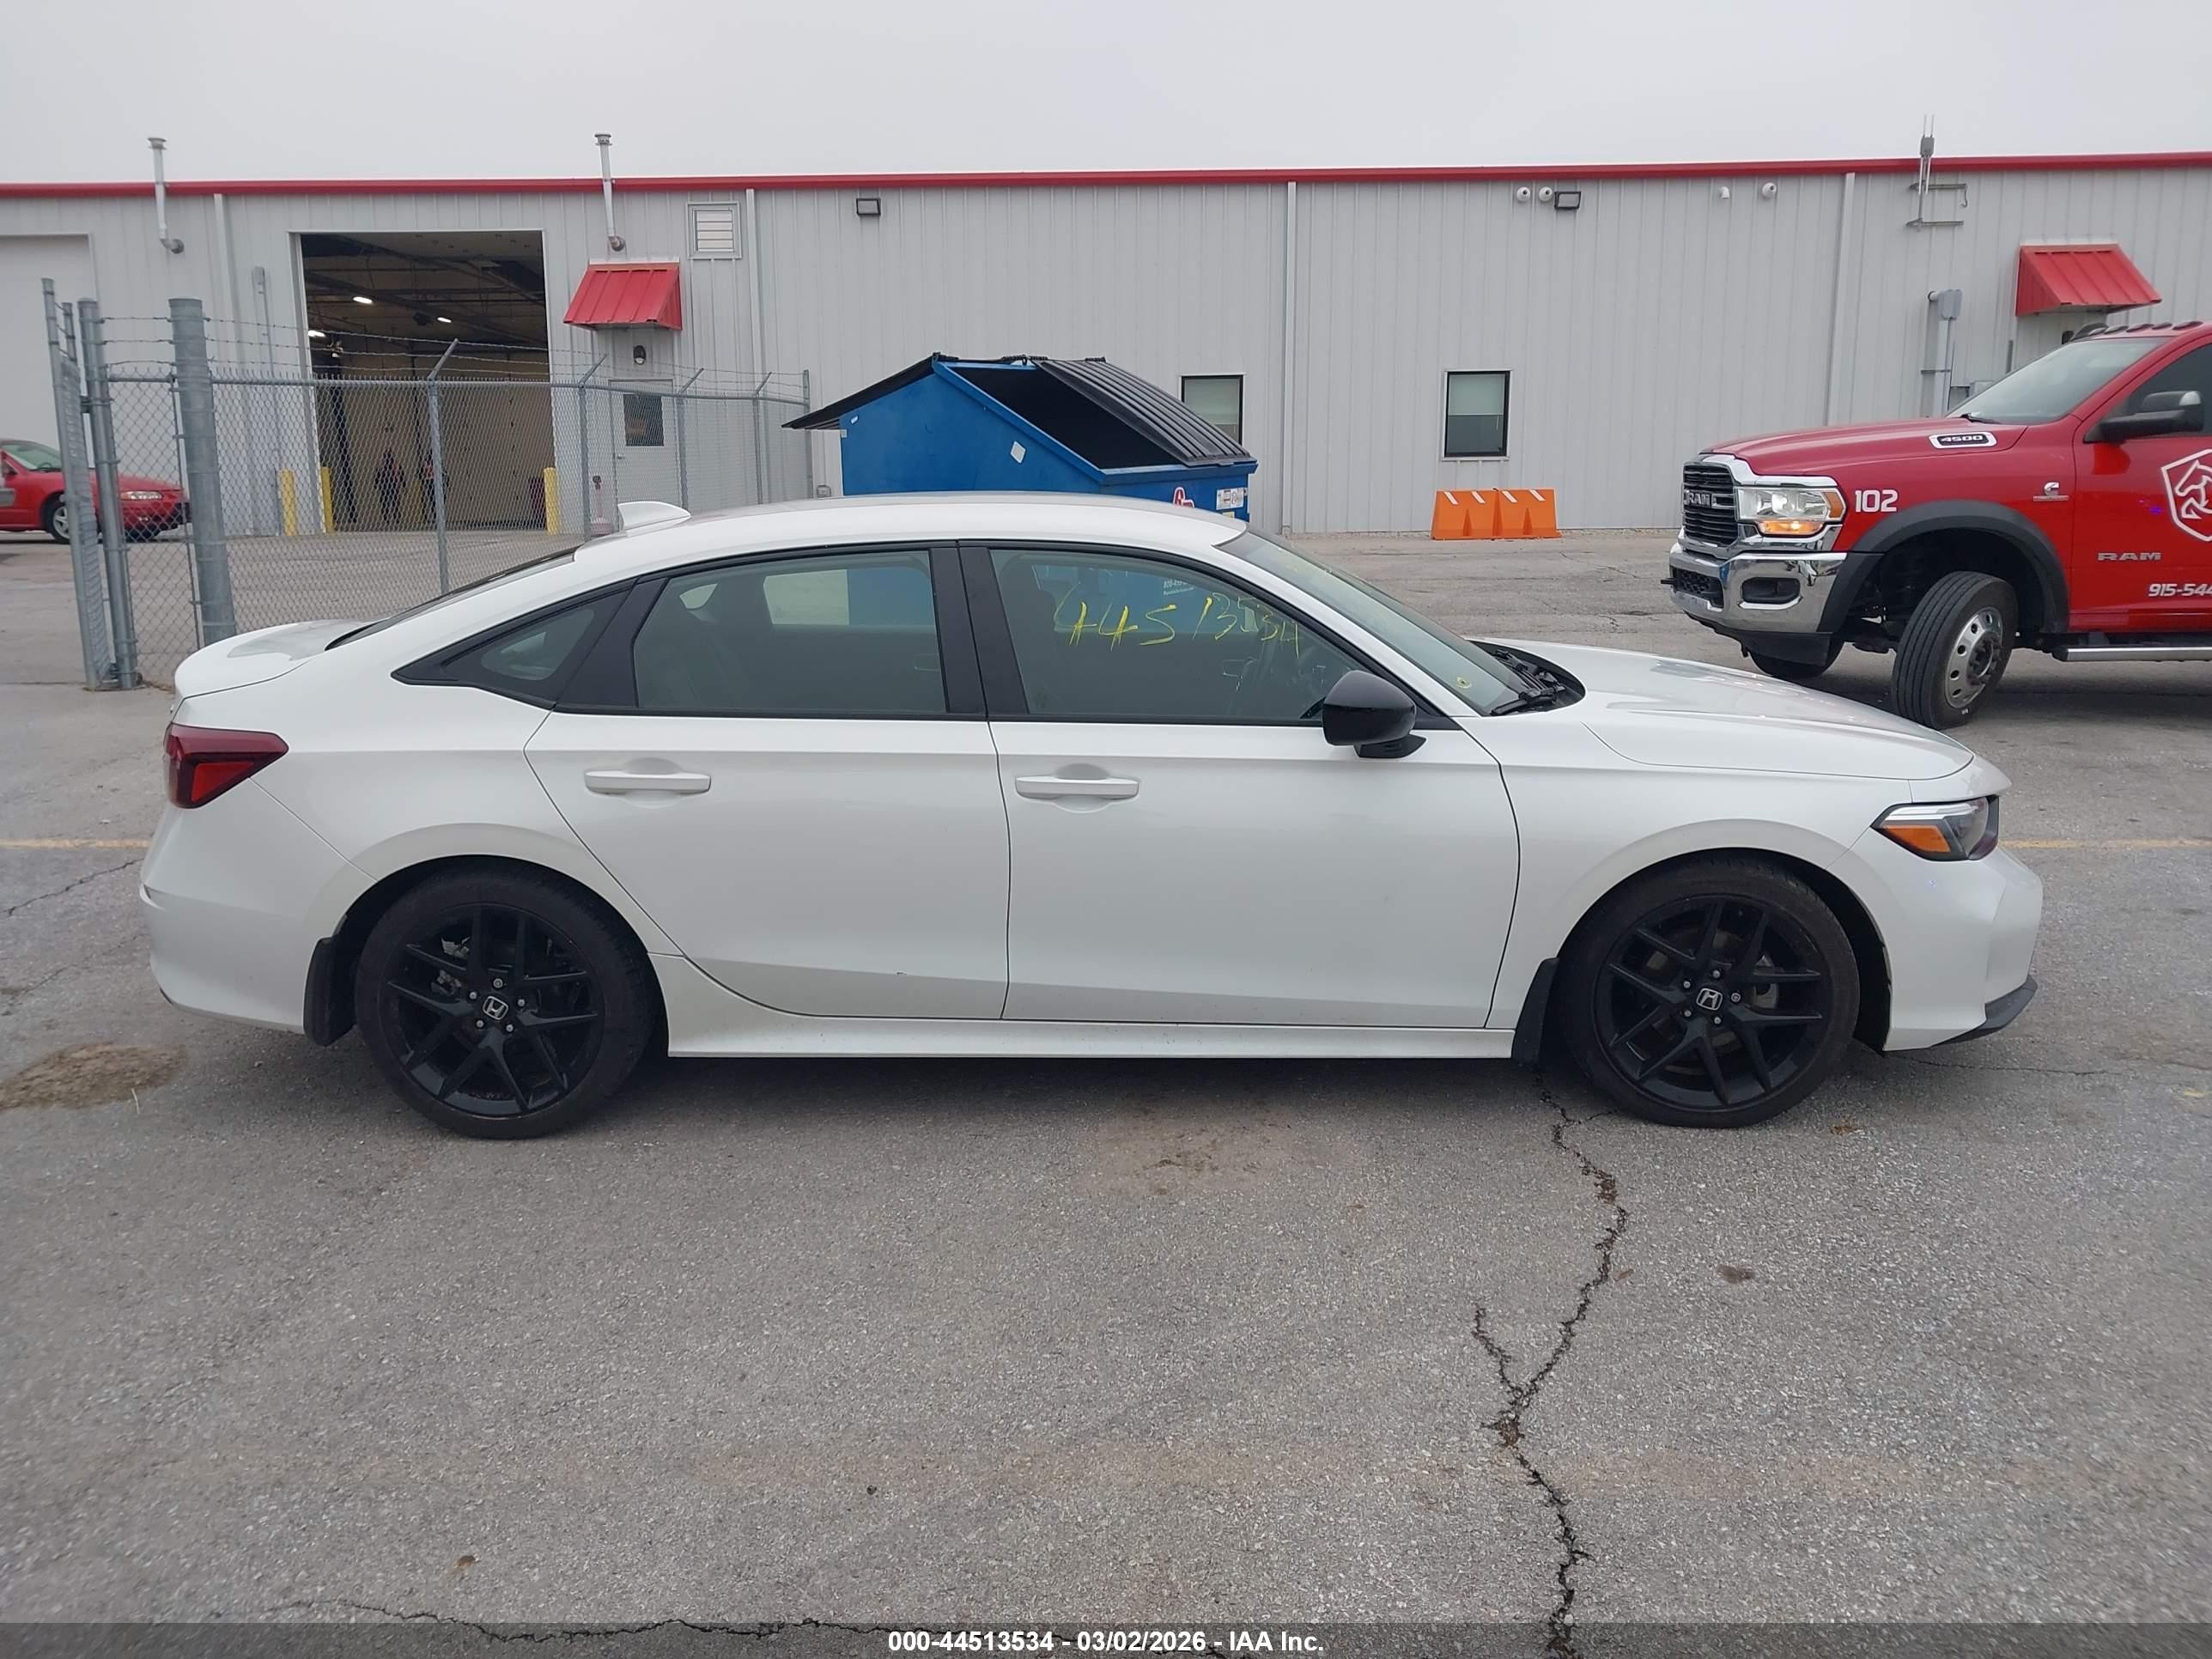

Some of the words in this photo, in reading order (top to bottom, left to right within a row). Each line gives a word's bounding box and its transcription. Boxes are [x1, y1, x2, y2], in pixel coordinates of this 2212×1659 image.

[1687, 492, 1711, 505] RAM
[1855, 489, 1899, 513] 102
[2097, 552, 2161, 561] RAM
